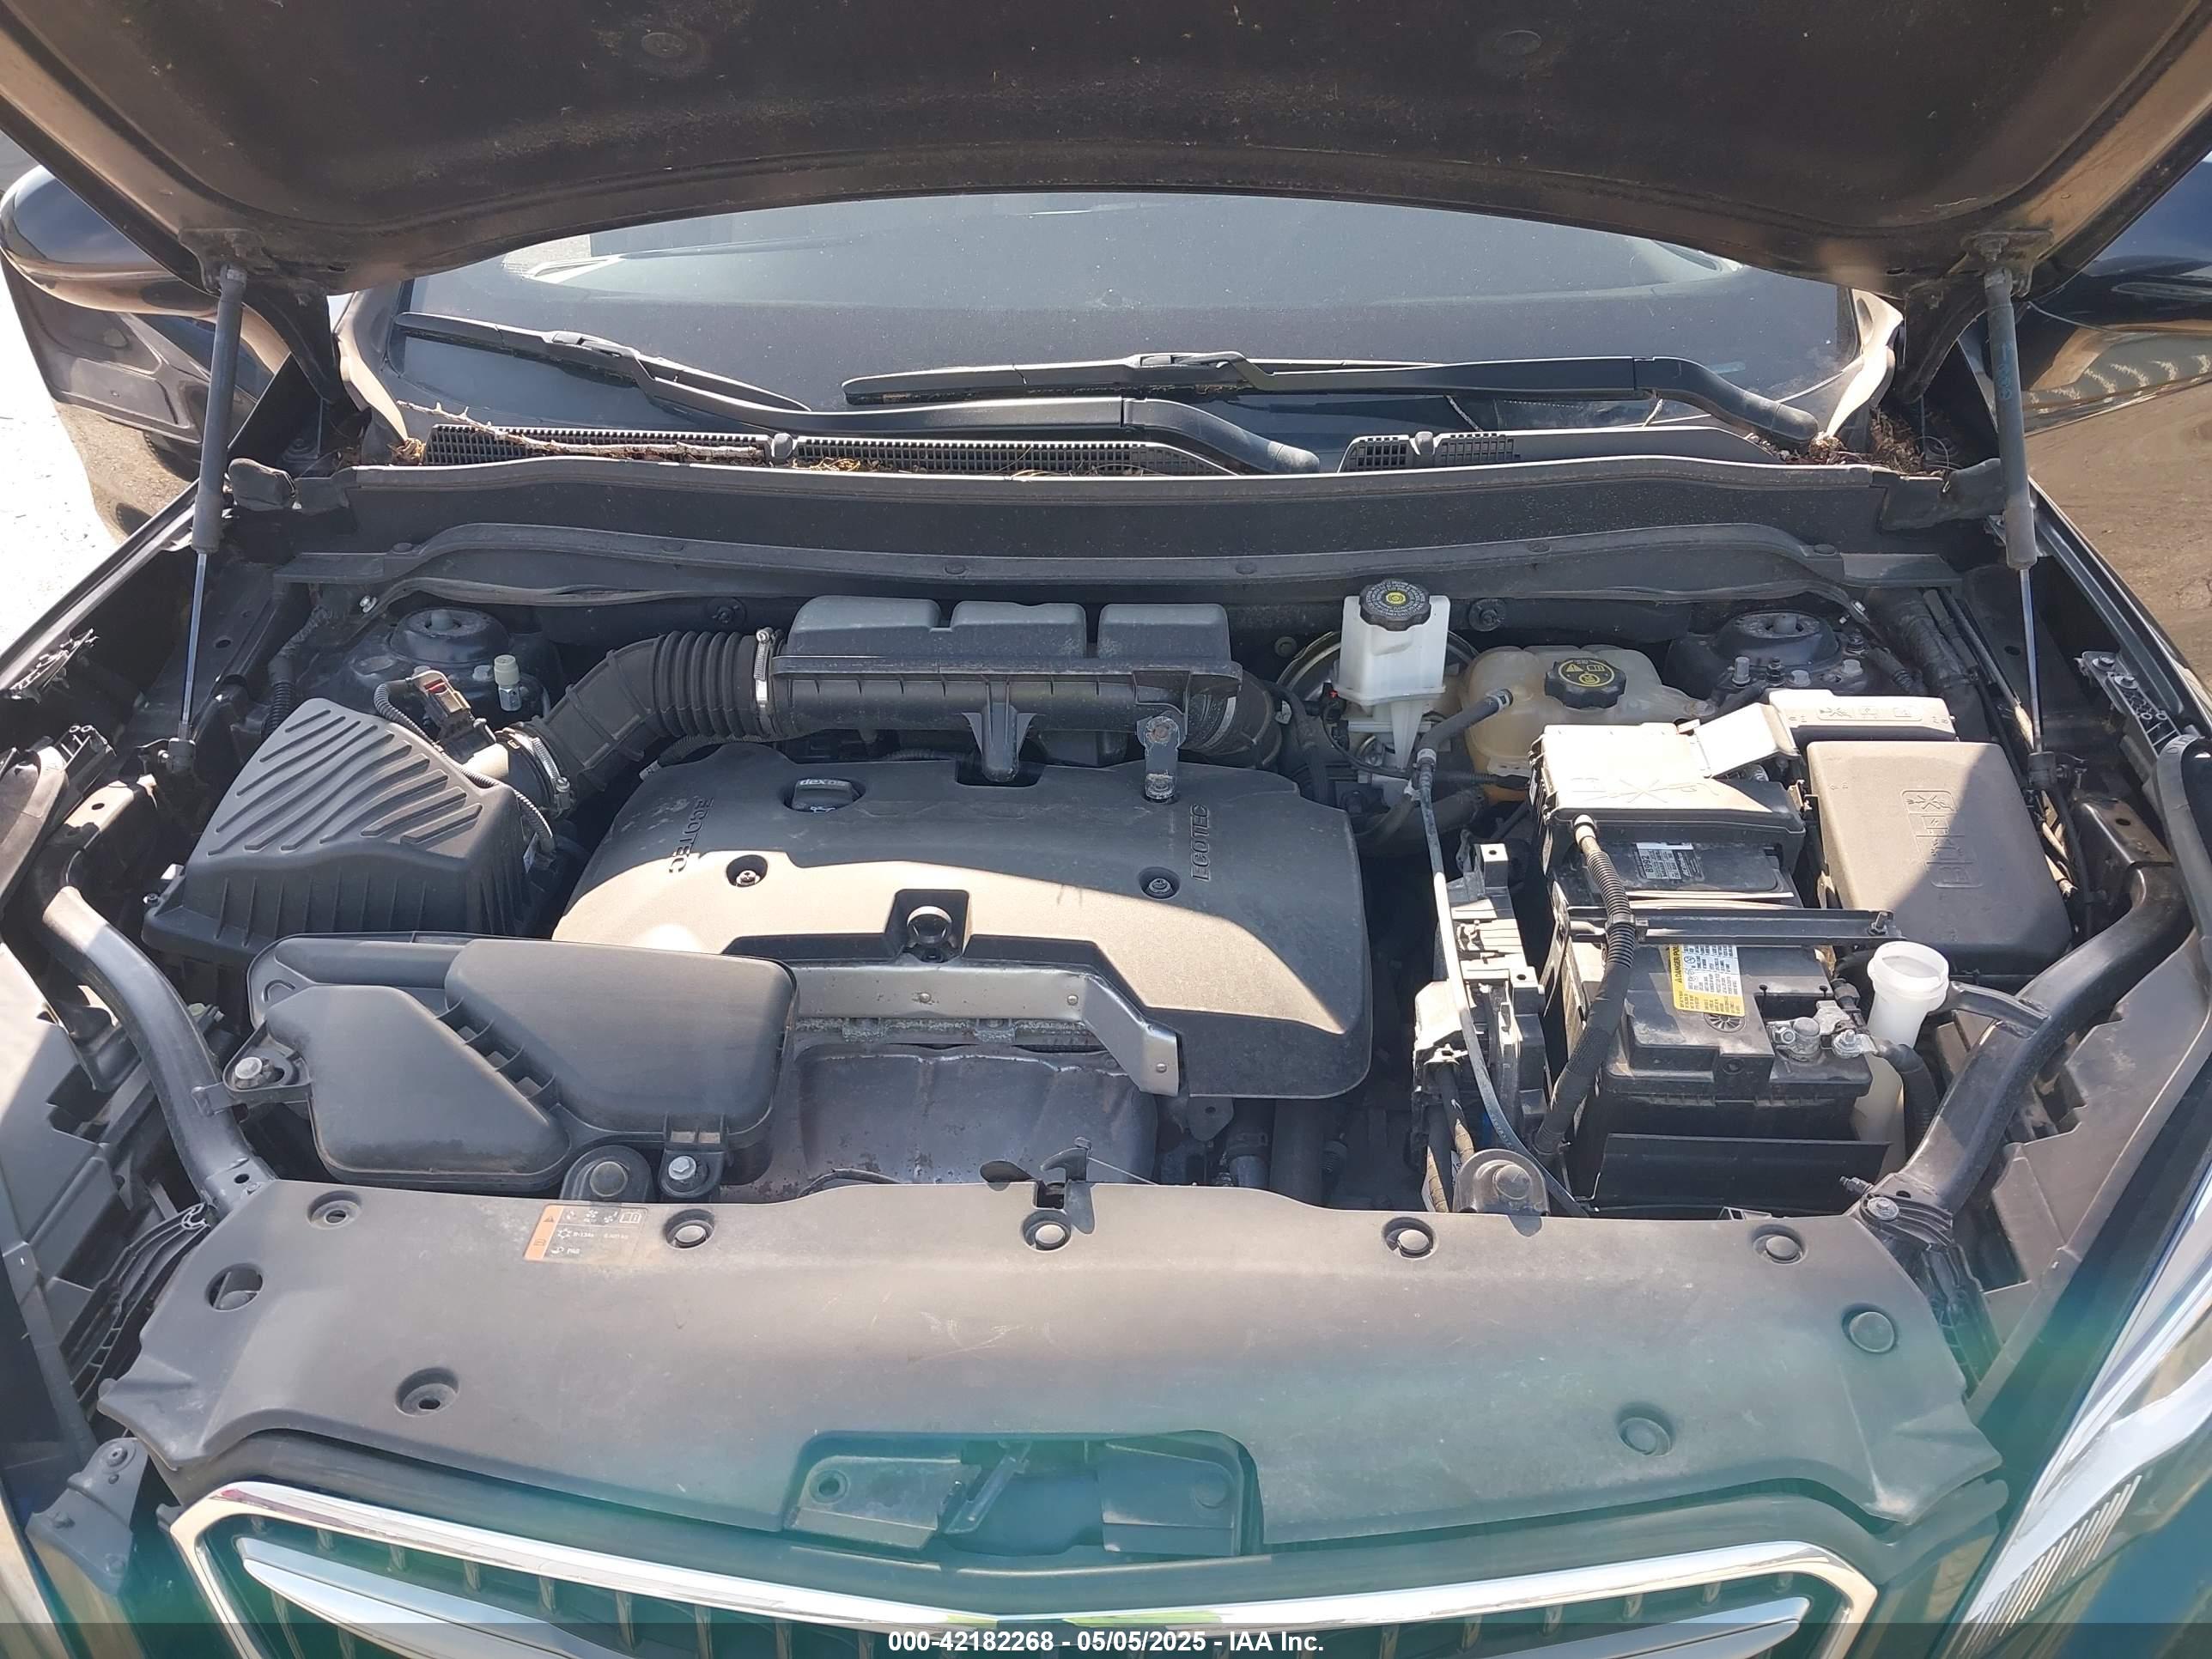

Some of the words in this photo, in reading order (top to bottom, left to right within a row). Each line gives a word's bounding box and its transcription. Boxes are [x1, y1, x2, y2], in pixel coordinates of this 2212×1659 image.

[799, 778, 846, 787] dexos
[669, 797, 714, 873] ECOTEC
[1190, 804, 1211, 882] ECOTEC
